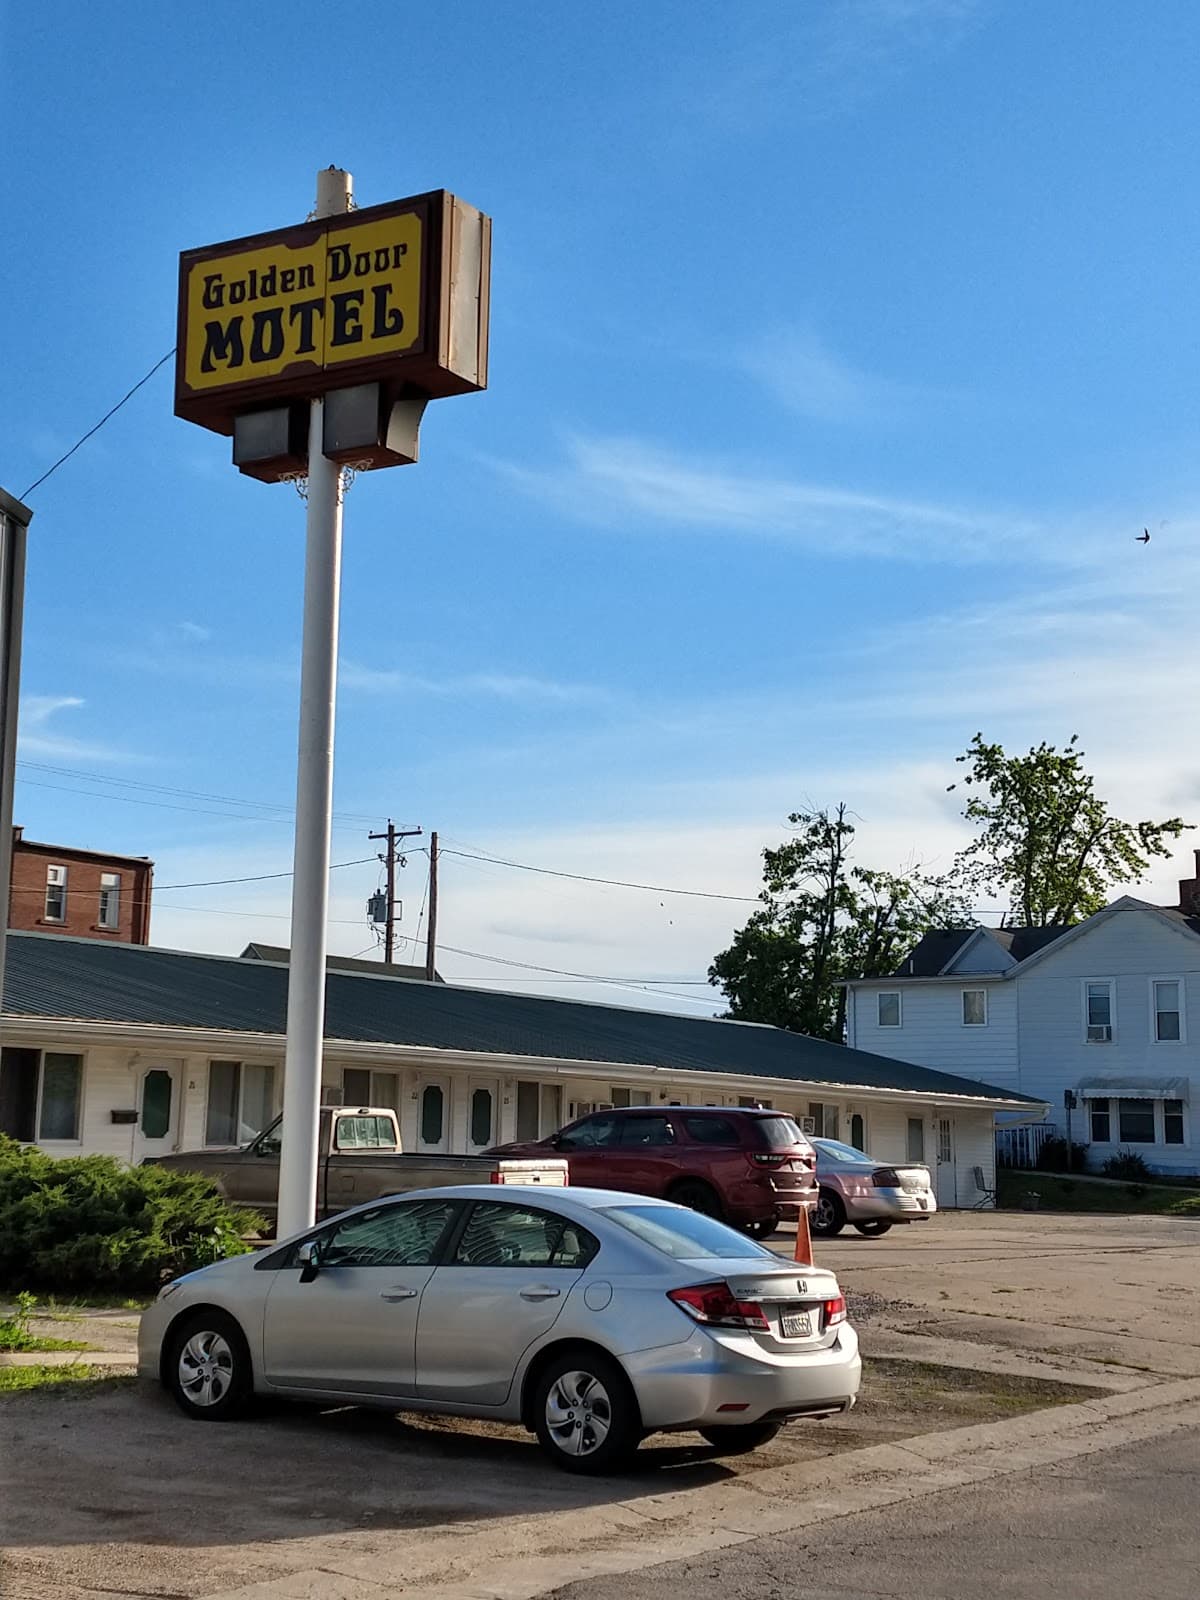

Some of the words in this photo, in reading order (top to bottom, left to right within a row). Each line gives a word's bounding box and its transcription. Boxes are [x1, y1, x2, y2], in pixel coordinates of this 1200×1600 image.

[202, 264, 315, 310] Golden
[327, 243, 408, 283] Door
[201, 284, 404, 373] MOTEL
